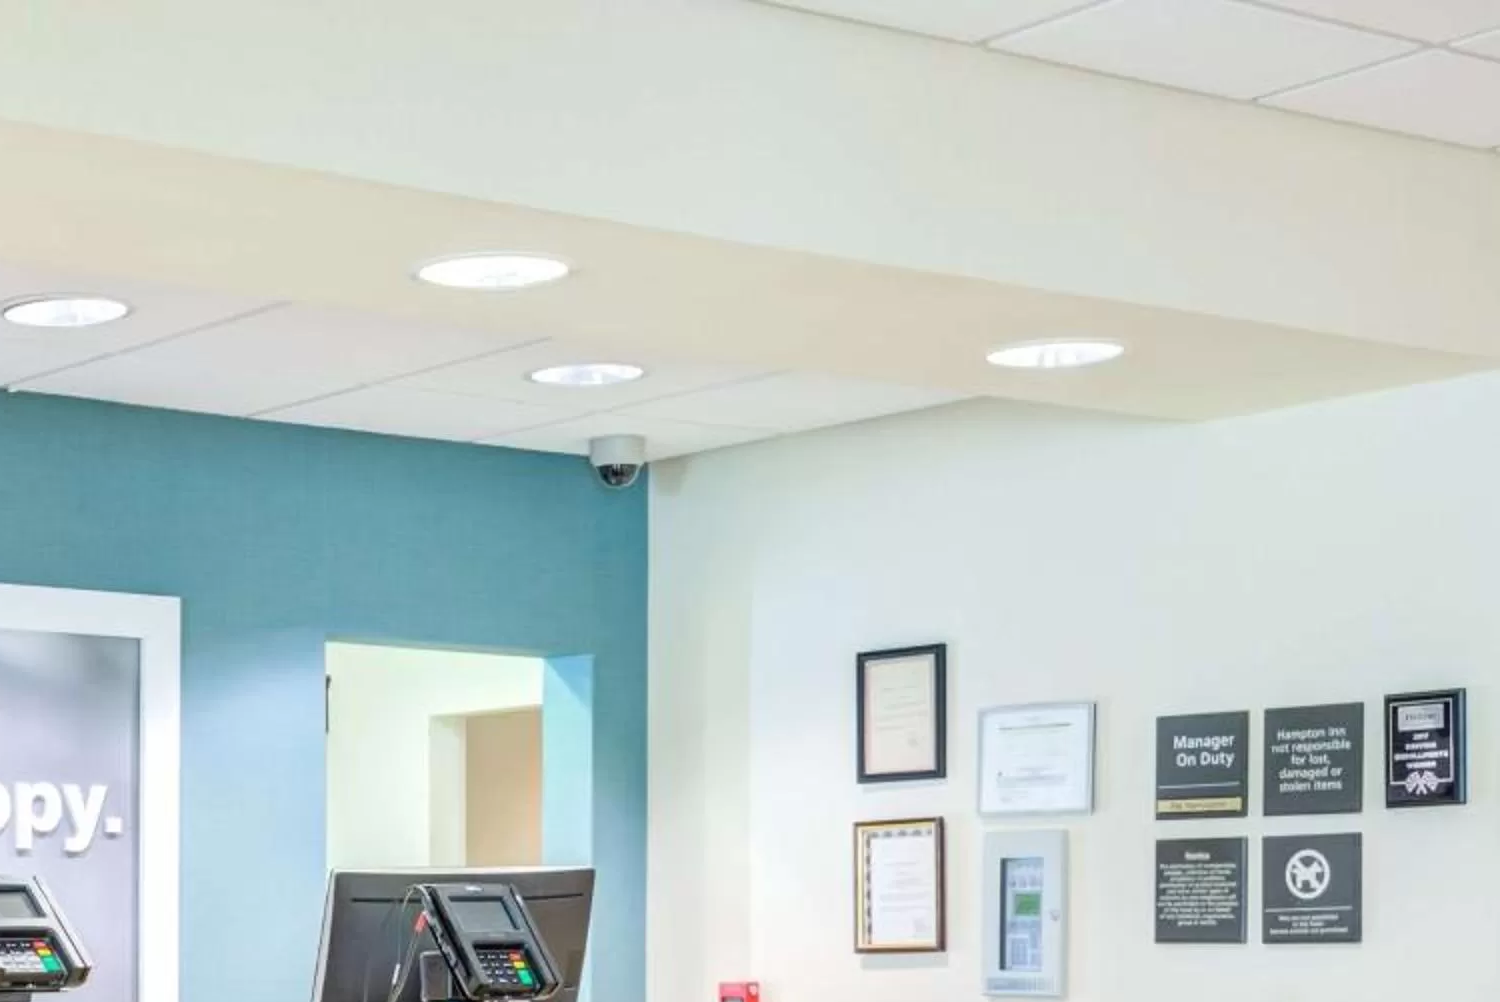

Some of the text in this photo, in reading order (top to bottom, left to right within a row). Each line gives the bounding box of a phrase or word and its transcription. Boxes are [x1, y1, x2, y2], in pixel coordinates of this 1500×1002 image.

[1277, 728, 1326, 741] Hampton
[1173, 735, 1236, 751] Manager
[1290, 738, 1352, 753] responsible
[1176, 751, 1236, 768] On Duty
[1291, 753, 1306, 765] for
[1278, 766, 1343, 781] damaged or
[1279, 780, 1343, 793] stolen items
